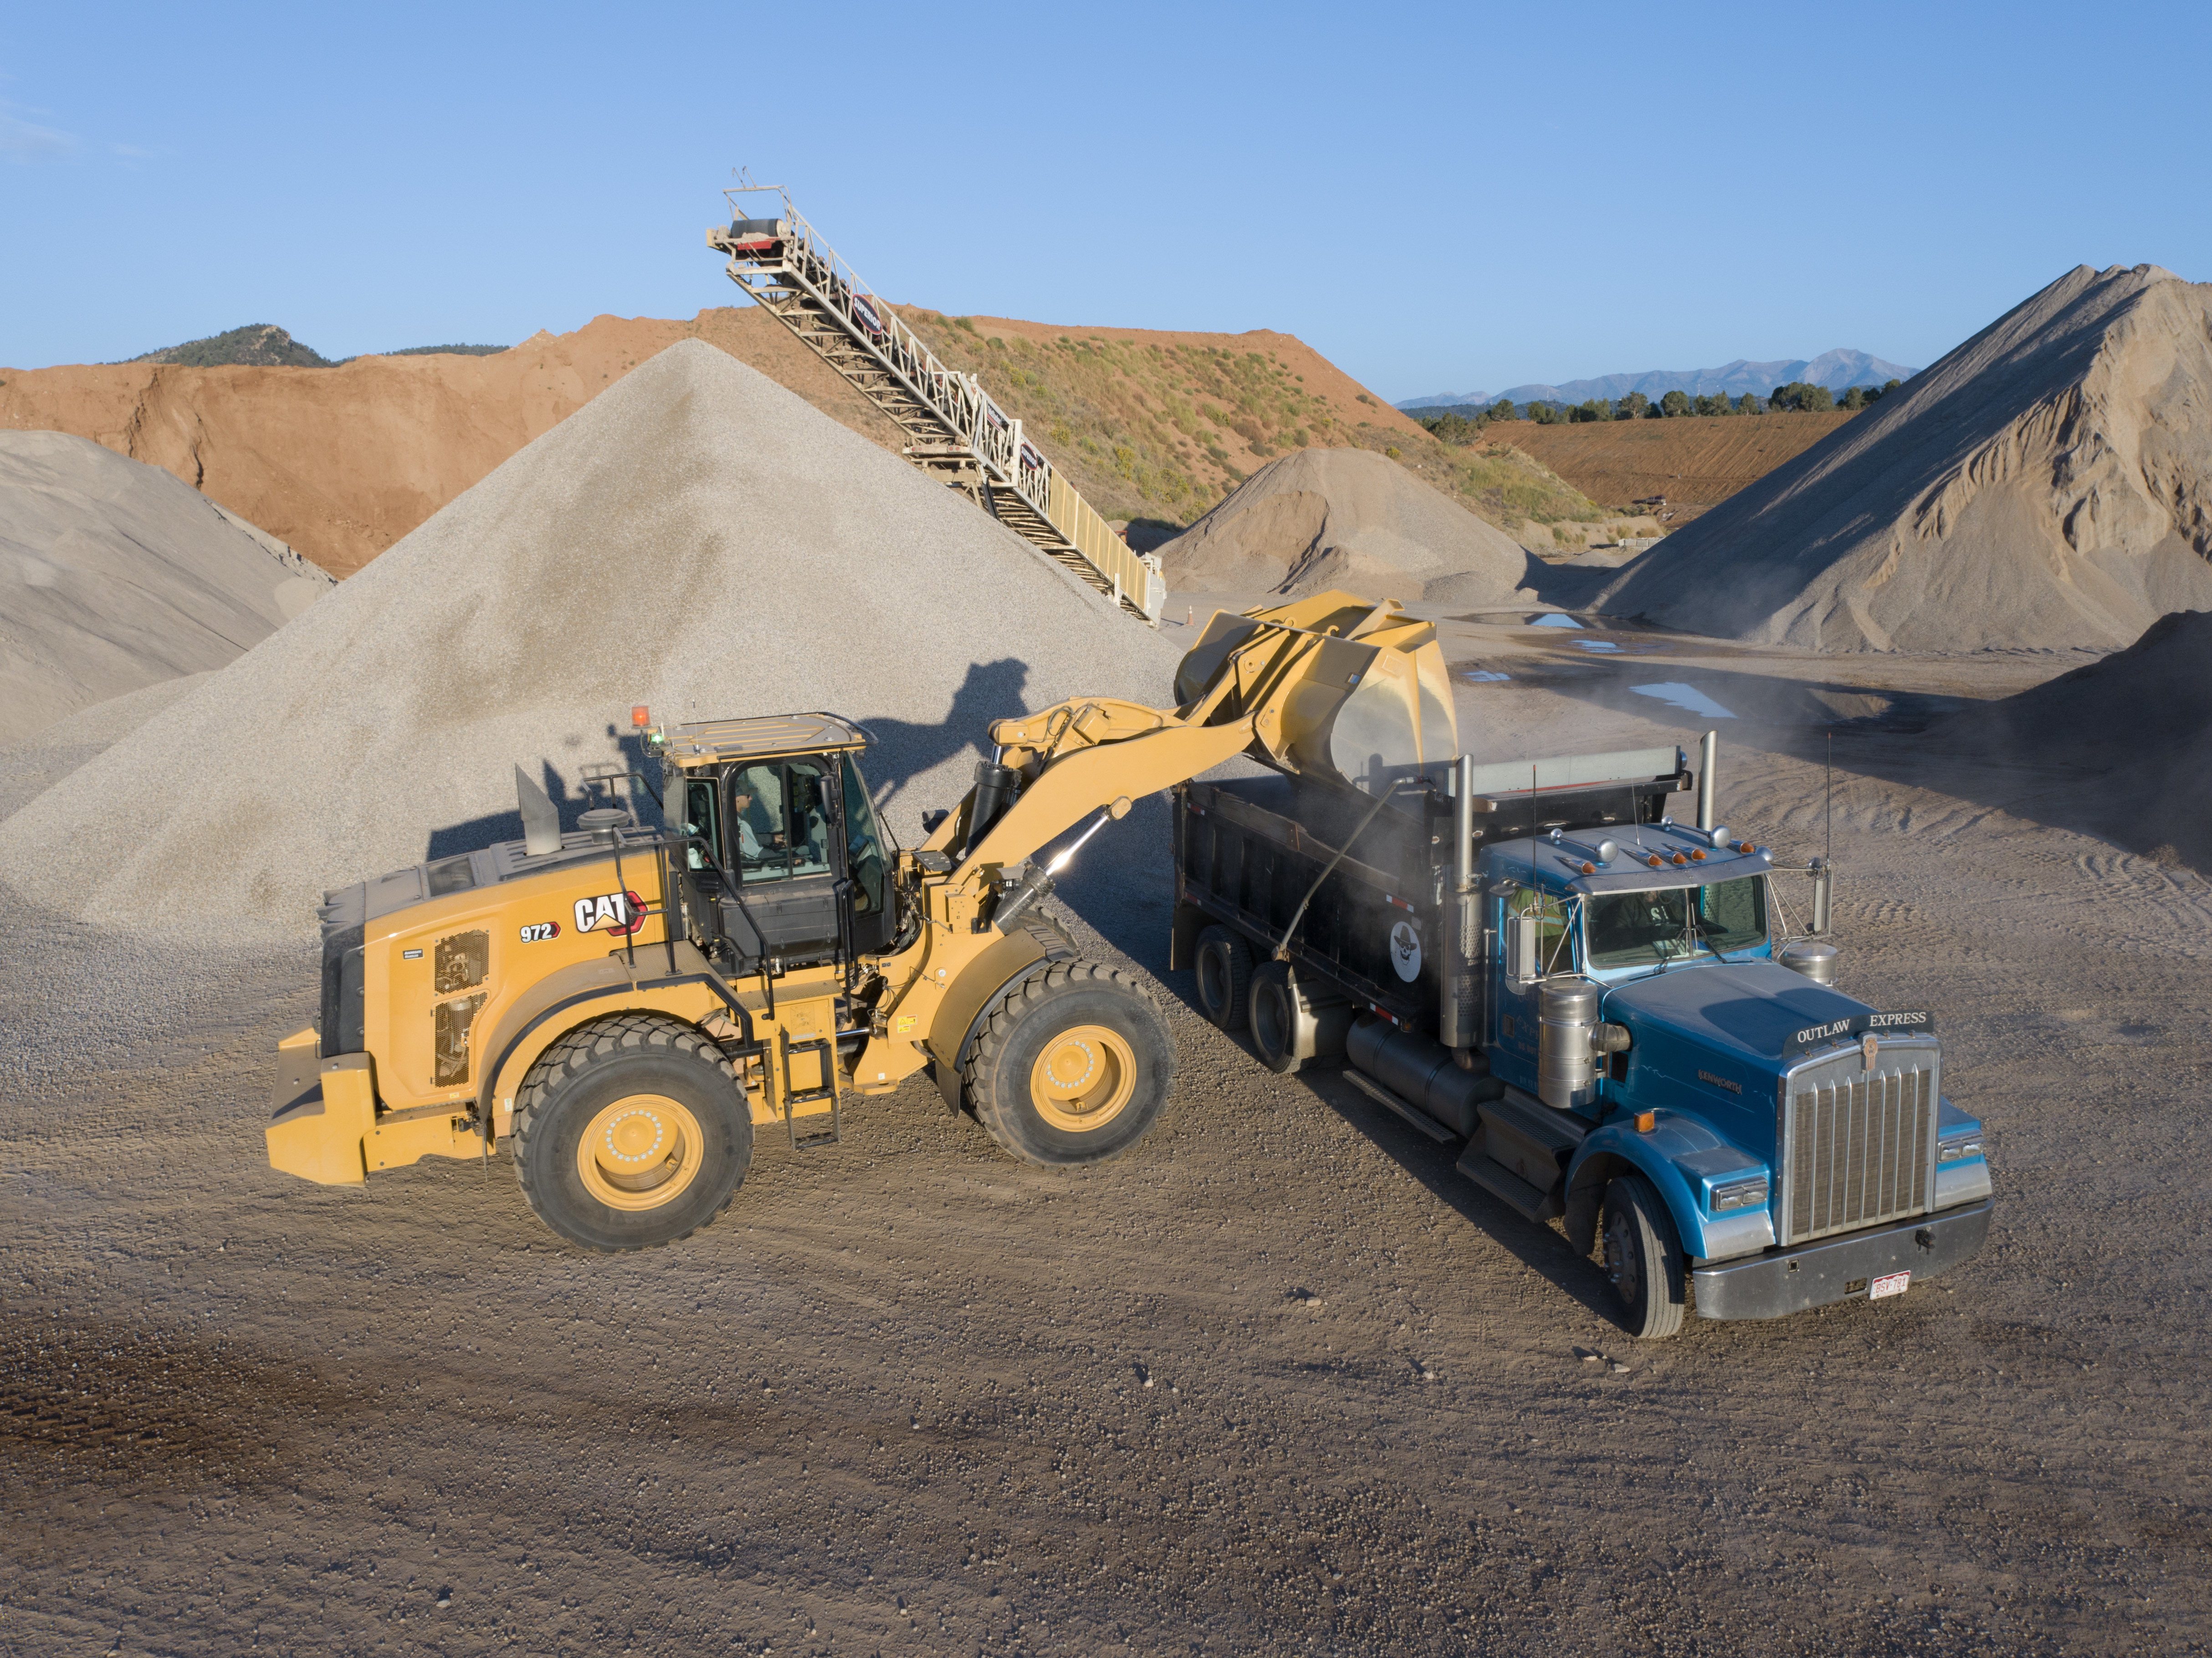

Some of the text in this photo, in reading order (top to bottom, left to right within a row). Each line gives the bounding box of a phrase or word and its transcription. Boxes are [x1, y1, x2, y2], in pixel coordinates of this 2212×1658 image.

[854, 297, 881, 331] SUPERIOR
[1021, 445, 1037, 467] SUPERIOR
[574, 893, 626, 932] CAT
[520, 923, 552, 942] 972
[1797, 1012, 1927, 1043] OUTLAW EXPRESS
[1698, 1069, 1742, 1096] KENWORTH
